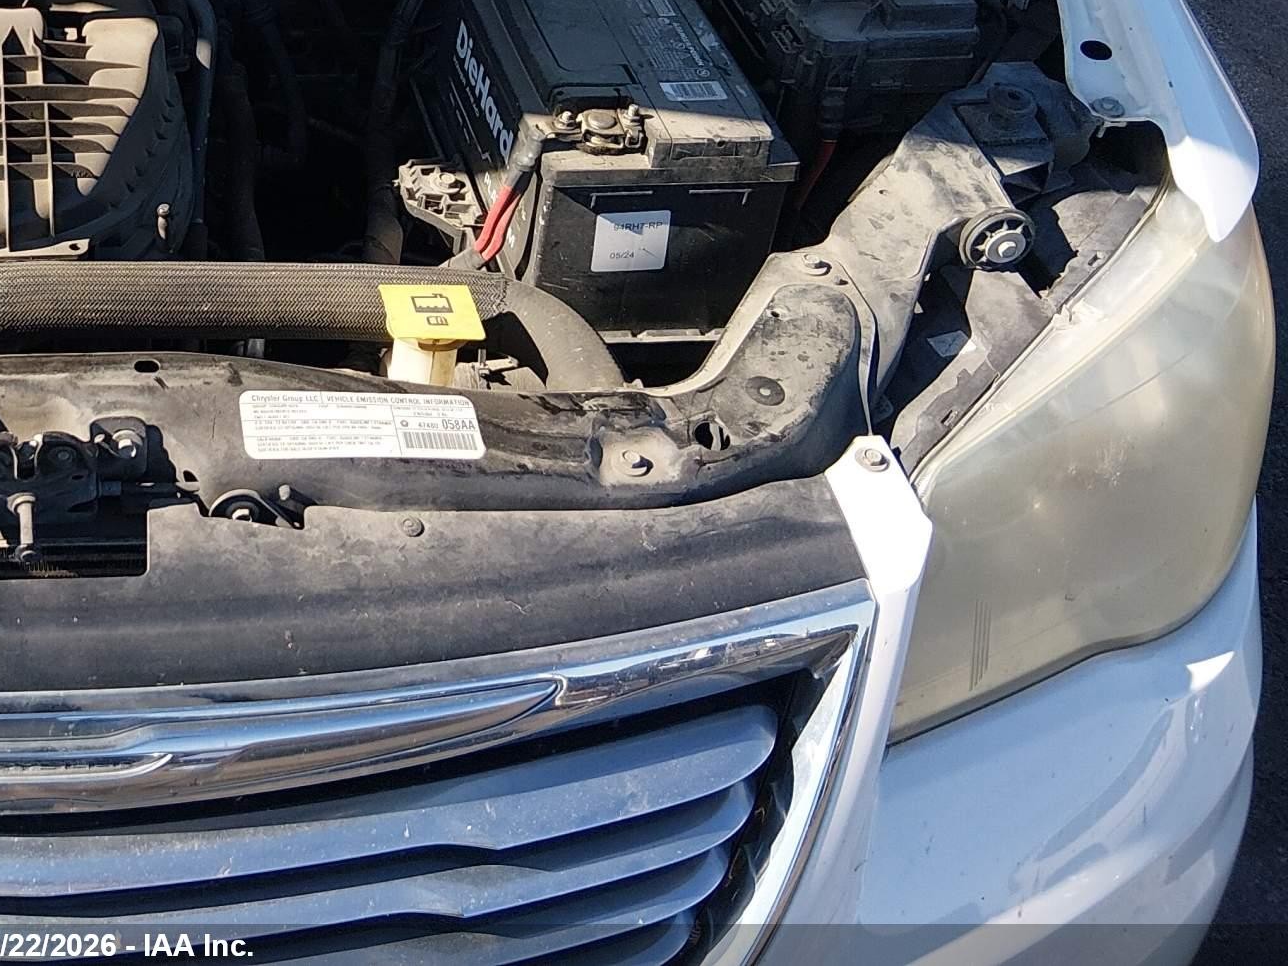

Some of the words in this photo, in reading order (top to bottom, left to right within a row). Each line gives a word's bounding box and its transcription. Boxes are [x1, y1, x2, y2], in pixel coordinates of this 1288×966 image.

[456, 18, 513, 167] DieHard
[609, 250, 635, 259] 05/24
[251, 394, 280, 403] Chrysler
[282, 394, 303, 403] Group
[305, 394, 319, 403] LLC
[326, 395, 354, 403] VEHICLE
[356, 396, 389, 404] EMISSION
[390, 397, 421, 405] CONTROL
[423, 398, 471, 407] INFORMATION
[441, 418, 477, 431] 058AA
